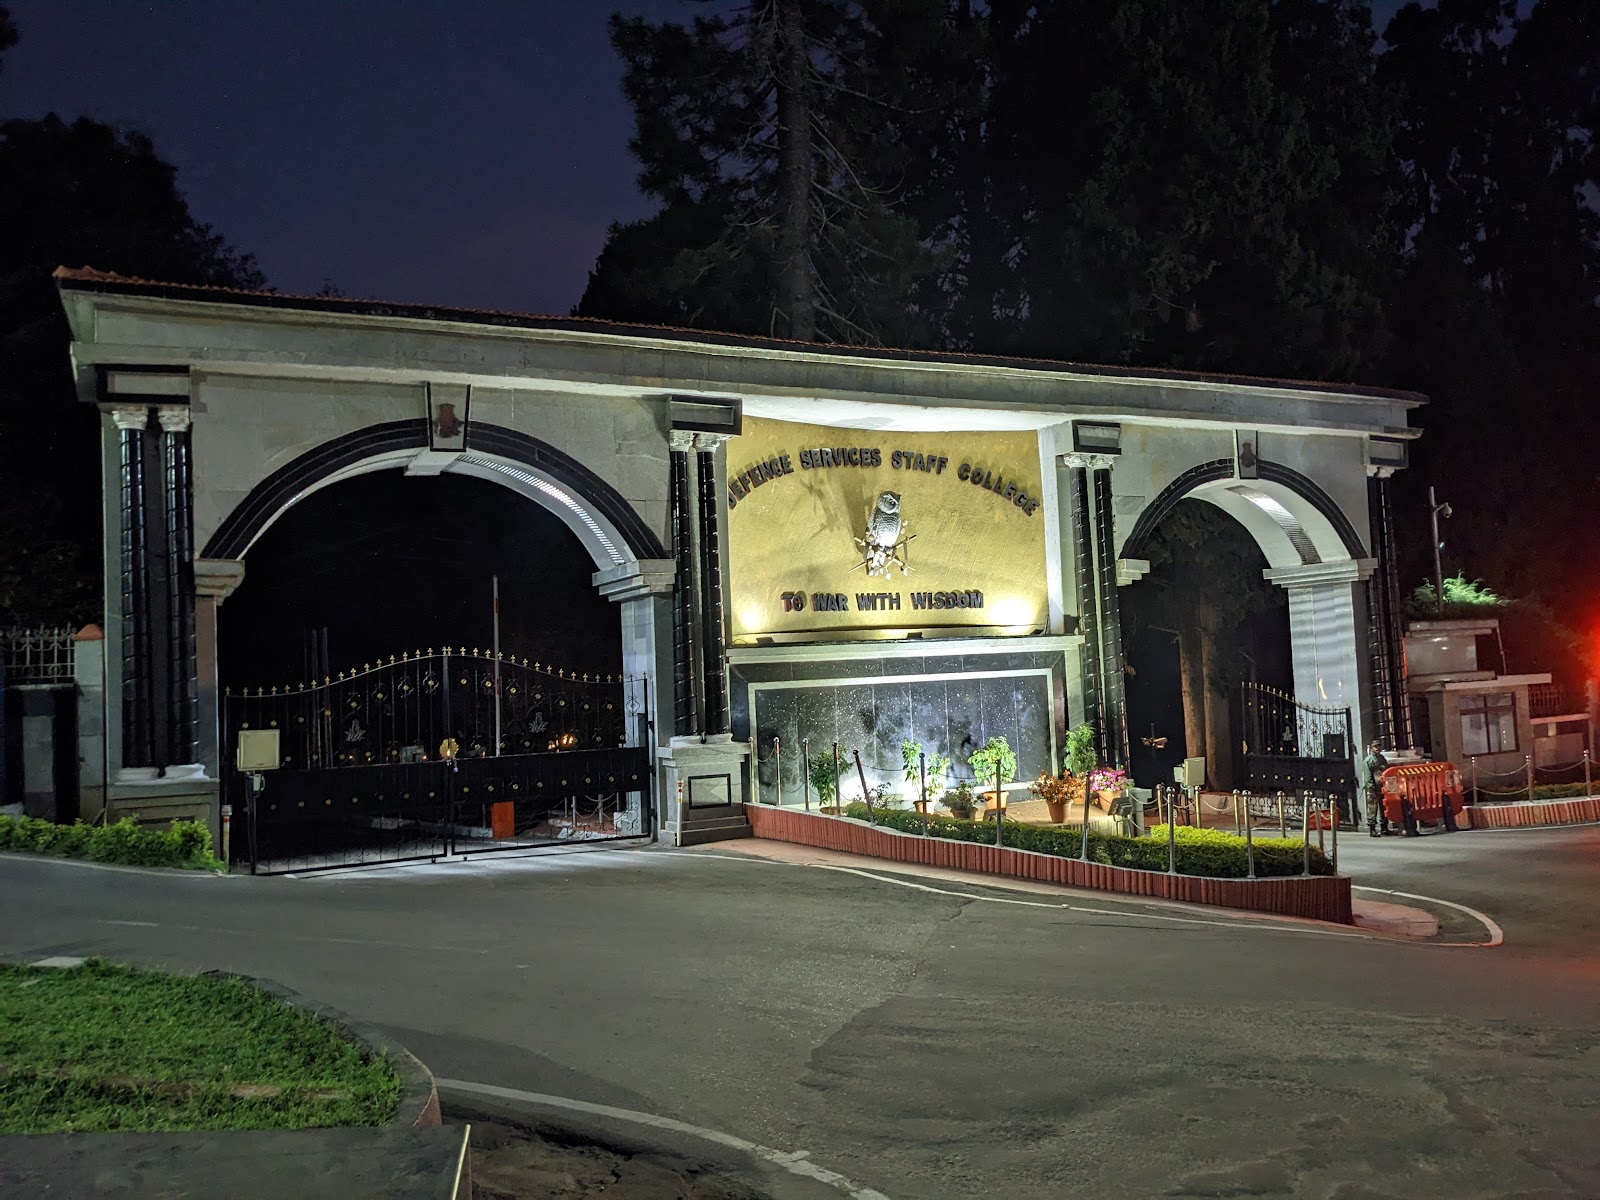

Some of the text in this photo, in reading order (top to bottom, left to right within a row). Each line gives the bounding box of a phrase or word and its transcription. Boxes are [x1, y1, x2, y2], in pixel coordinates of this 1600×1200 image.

[800, 448, 882, 470] SERVICES
[892, 450, 949, 474] STAFF
[958, 463, 1040, 517] COLLEGE
[782, 591, 984, 612] TO WAR WITH WISDOM
